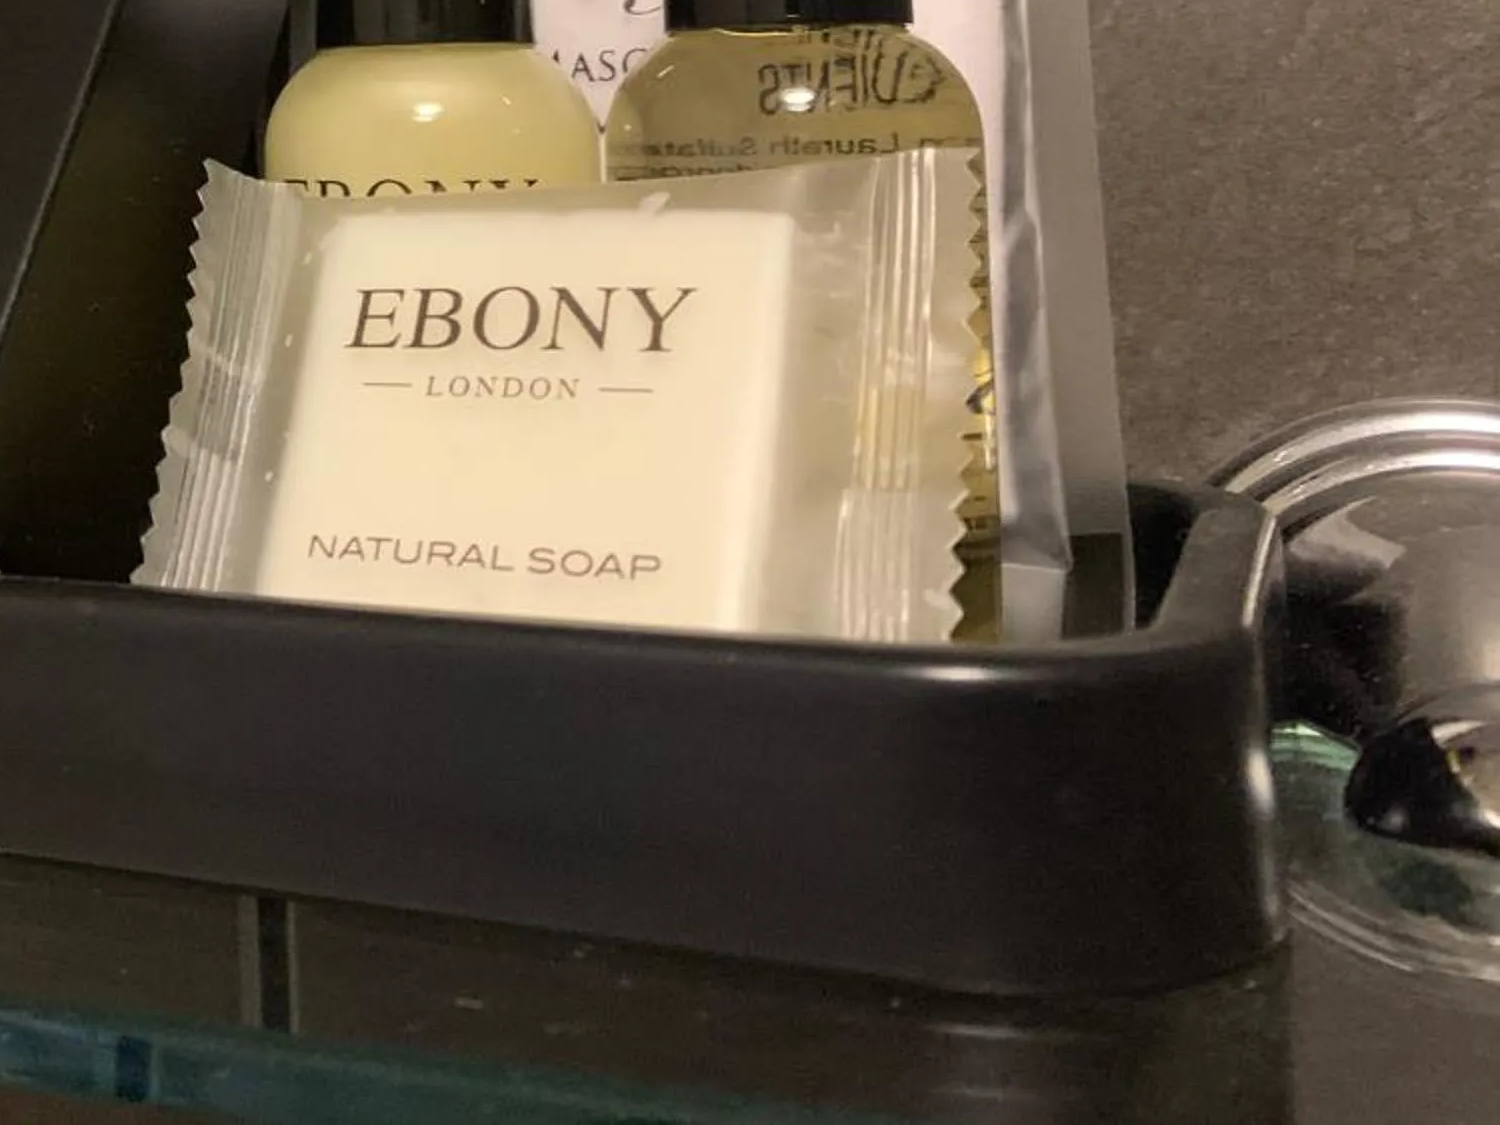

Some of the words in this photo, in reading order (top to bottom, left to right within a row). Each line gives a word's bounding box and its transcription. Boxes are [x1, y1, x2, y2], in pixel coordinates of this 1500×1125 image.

[343, 285, 697, 352] EBONY
[425, 376, 580, 400] LONDON
[307, 535, 515, 571] NATURAL
[526, 548, 662, 580] SOAP
